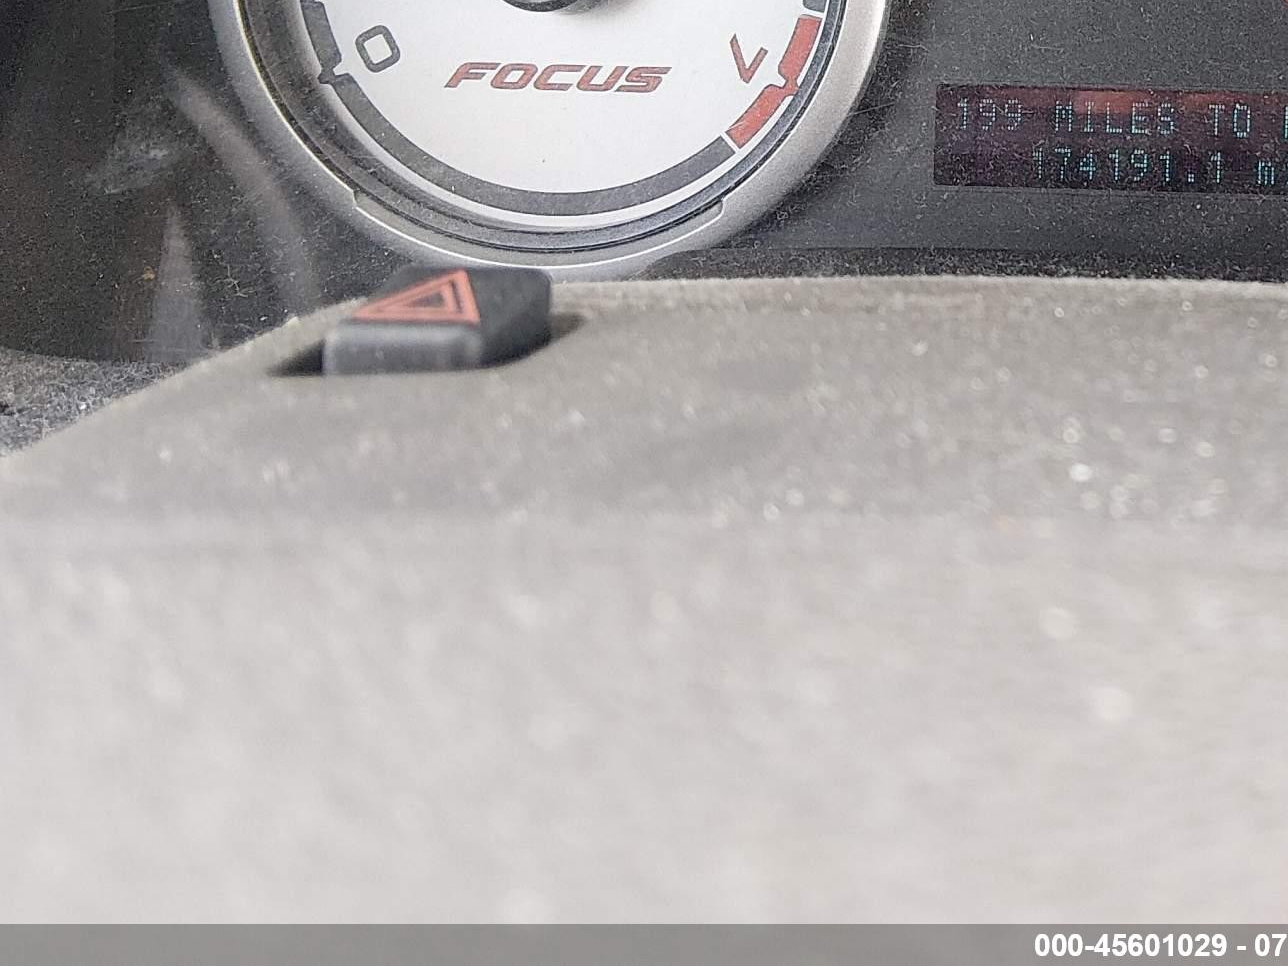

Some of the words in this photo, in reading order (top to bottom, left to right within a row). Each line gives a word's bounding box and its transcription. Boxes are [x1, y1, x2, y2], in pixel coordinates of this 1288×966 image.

[354, 24, 402, 73] 0
[729, 33, 769, 84] 7
[443, 62, 672, 93] FOCUS
[957, 98, 1022, 131] 199
[1055, 100, 1174, 134] MILES
[1209, 103, 1250, 138] TO
[1033, 147, 1220, 183] 174191.1
